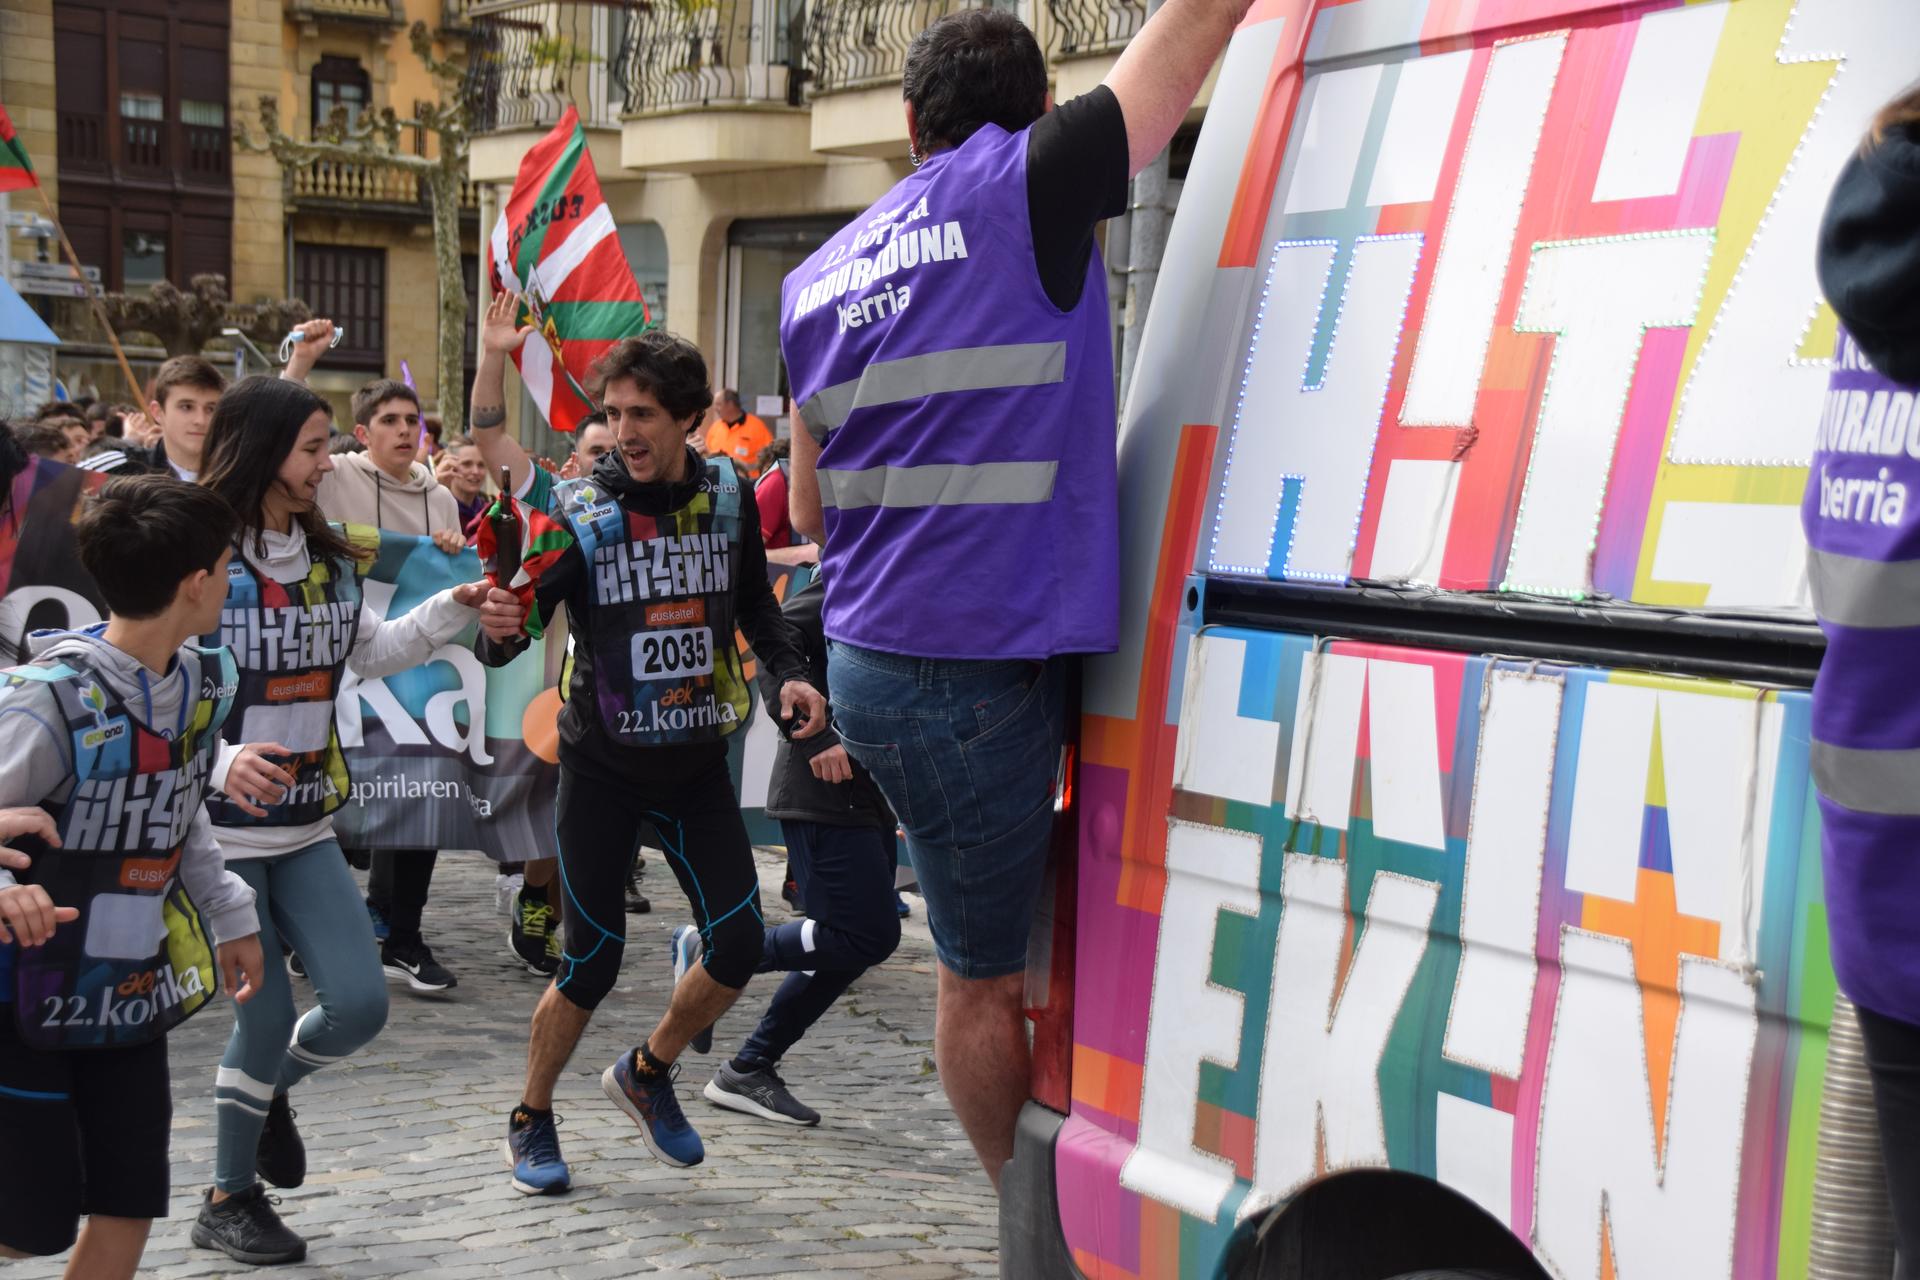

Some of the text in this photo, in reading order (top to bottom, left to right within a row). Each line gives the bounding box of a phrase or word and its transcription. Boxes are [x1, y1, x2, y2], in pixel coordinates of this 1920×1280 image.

[836, 282, 911, 336] berria
[1819, 464, 1907, 526] berria
[650, 607, 695, 622] euskaltel
[643, 631, 708, 674] 2035
[660, 685, 694, 707] aek
[350, 773, 460, 807] apirilaren
